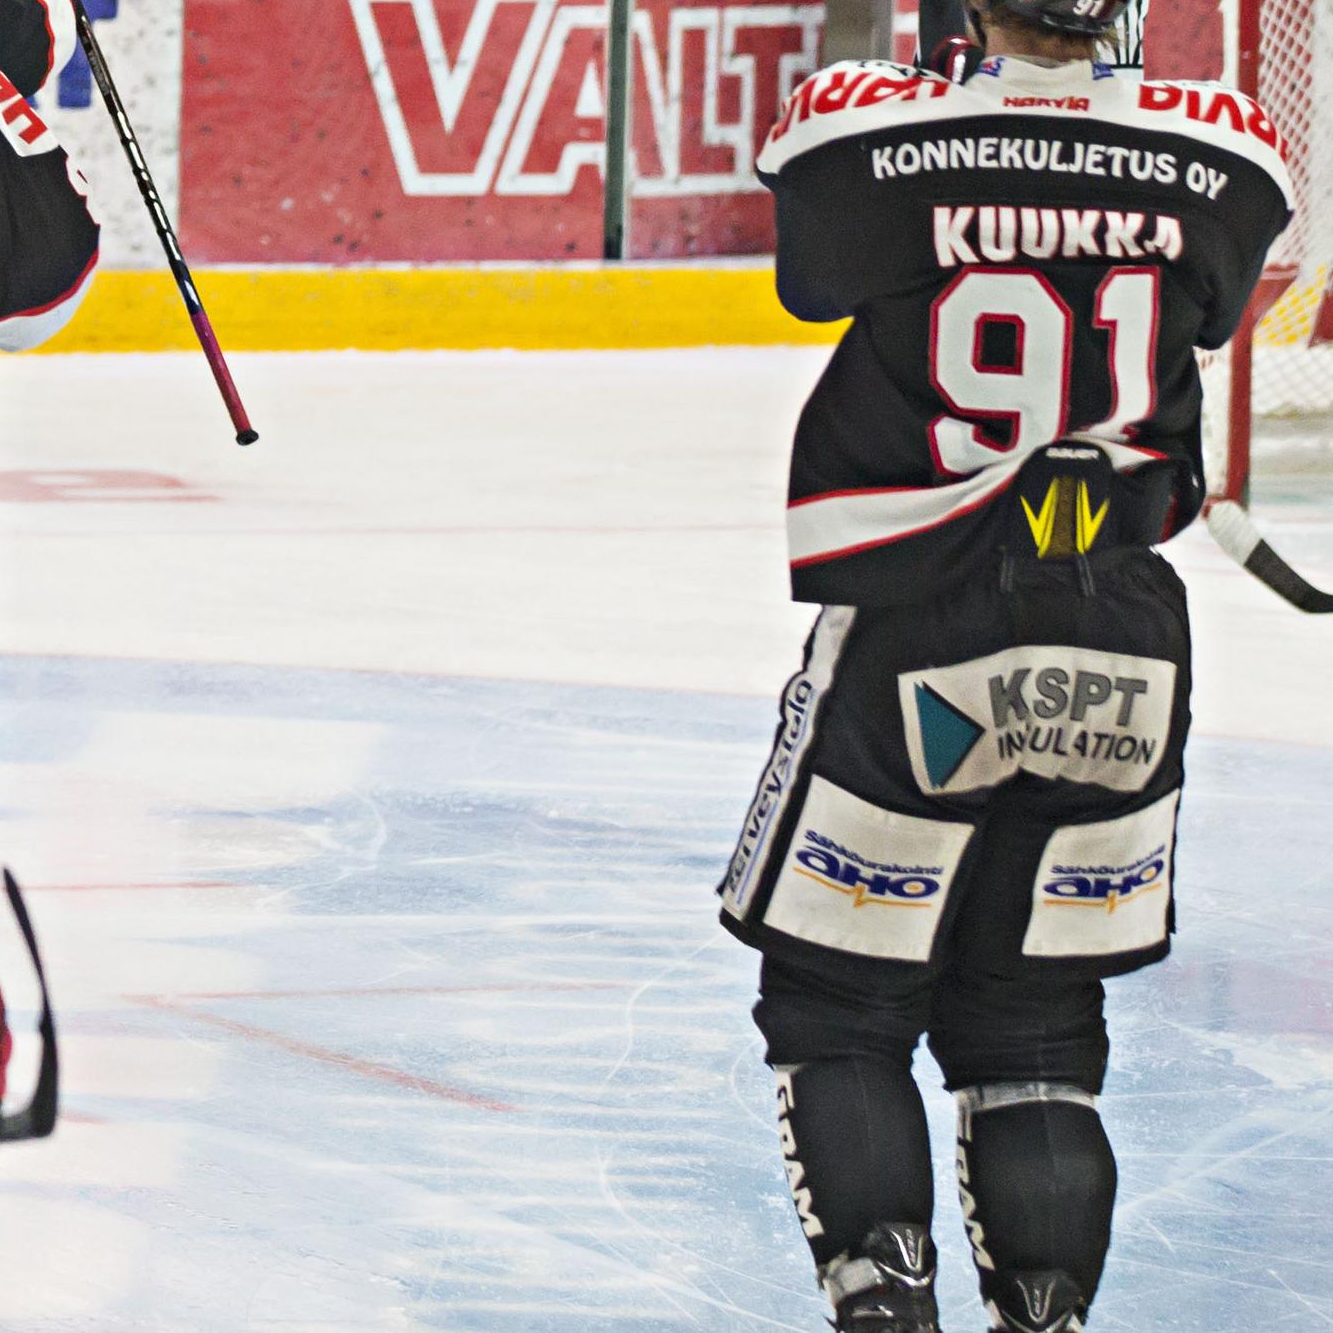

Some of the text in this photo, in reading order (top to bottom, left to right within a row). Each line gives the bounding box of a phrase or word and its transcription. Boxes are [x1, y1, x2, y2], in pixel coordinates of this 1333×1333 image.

[872, 136, 1229, 201] KONNEKULJETUS OY
[932, 204, 1185, 269] KUUKKA
[927, 265, 1161, 479] 91
[987, 667, 1148, 729] KSPT
[996, 722, 1157, 766] INULATION
